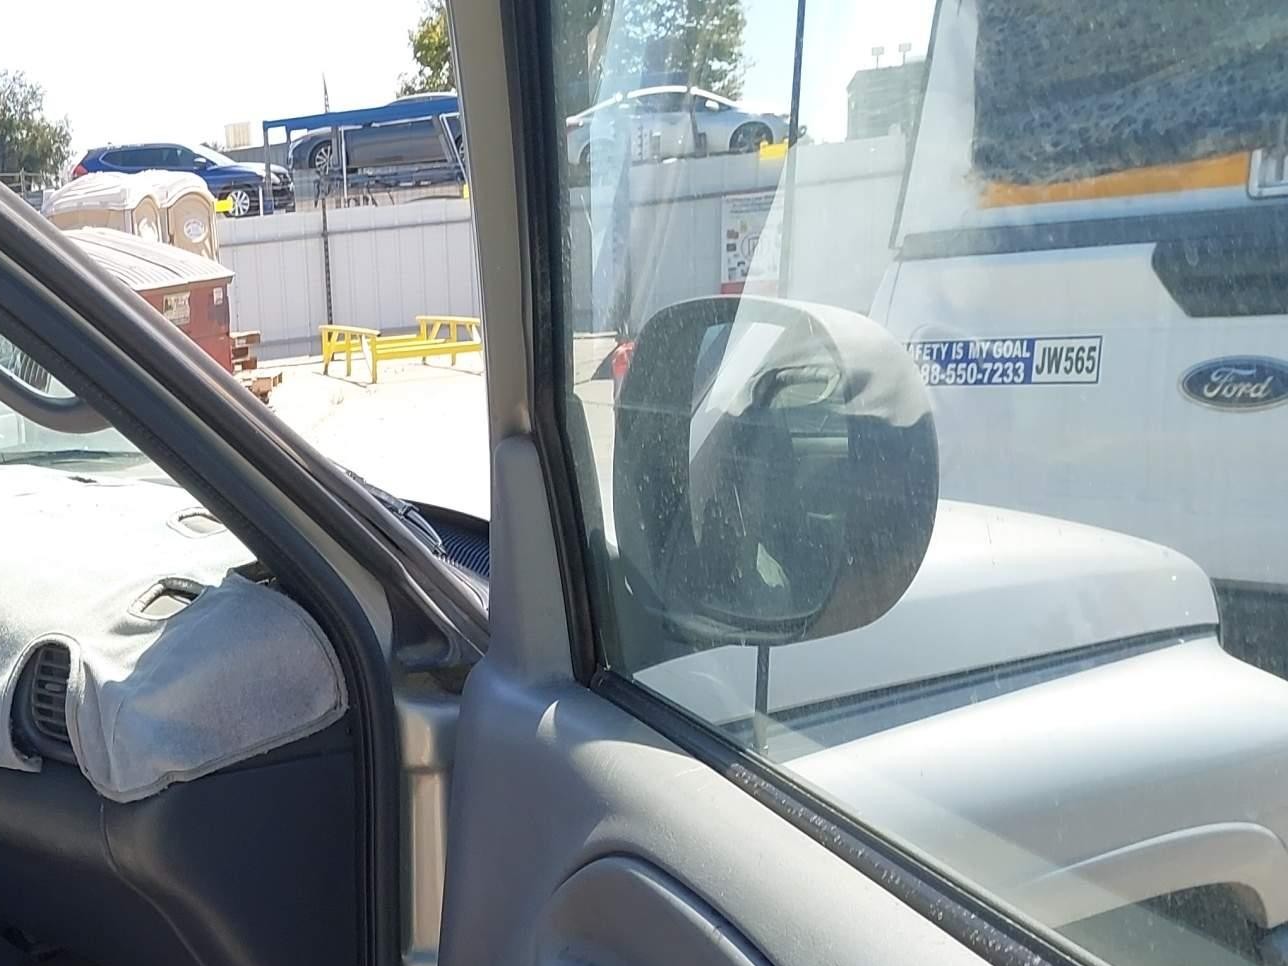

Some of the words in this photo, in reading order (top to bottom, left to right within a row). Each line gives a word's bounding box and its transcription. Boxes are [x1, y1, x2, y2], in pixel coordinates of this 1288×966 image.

[906, 342, 949, 361] AFETY
[951, 342, 964, 361] IS
[968, 341, 991, 361] MY
[993, 339, 1031, 359] GOAL
[1035, 345, 1098, 375] JW565
[914, 361, 1026, 385] 88-550-7233
[1203, 366, 1275, 398] Ford
